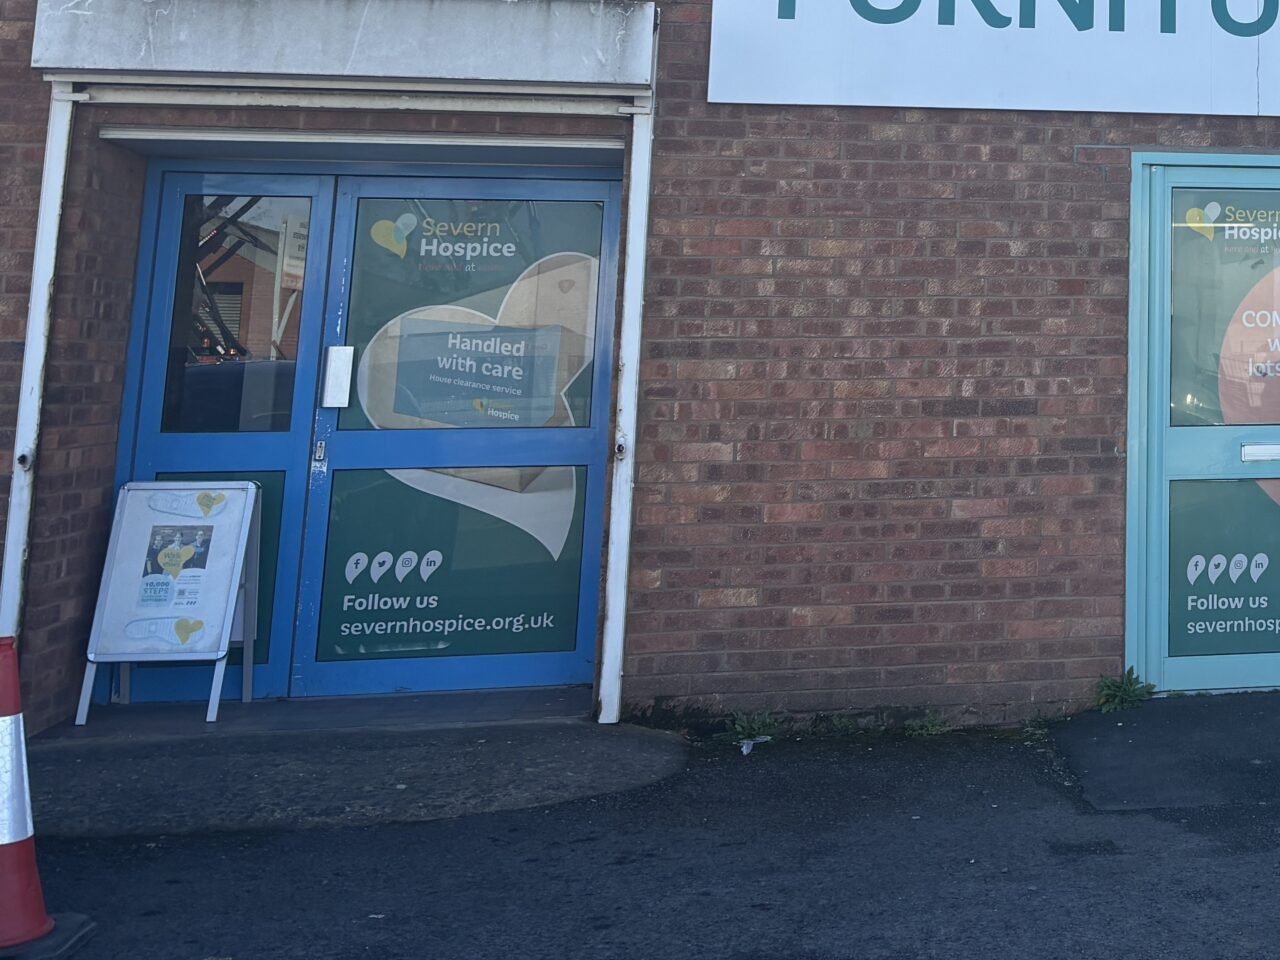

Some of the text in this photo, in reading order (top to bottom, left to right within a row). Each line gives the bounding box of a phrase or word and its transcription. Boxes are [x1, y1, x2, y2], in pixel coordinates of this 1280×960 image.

[422, 218, 500, 236] Severn
[419, 237, 516, 261] Hospice
[1260, 245, 1269, 254] at
[464, 262, 476, 272] at
[447, 333, 526, 357] Handled
[437, 355, 524, 380] with care
[429, 374, 522, 396] House clearance service
[487, 407, 520, 421] Hospice
[426, 557, 436, 567] in
[1255, 560, 1264, 569] in
[143, 587, 169, 595] STEPS
[342, 594, 438, 611] Follow us
[1187, 594, 1268, 611] Follow us
[340, 612, 555, 636] severnhospice.org.uk
